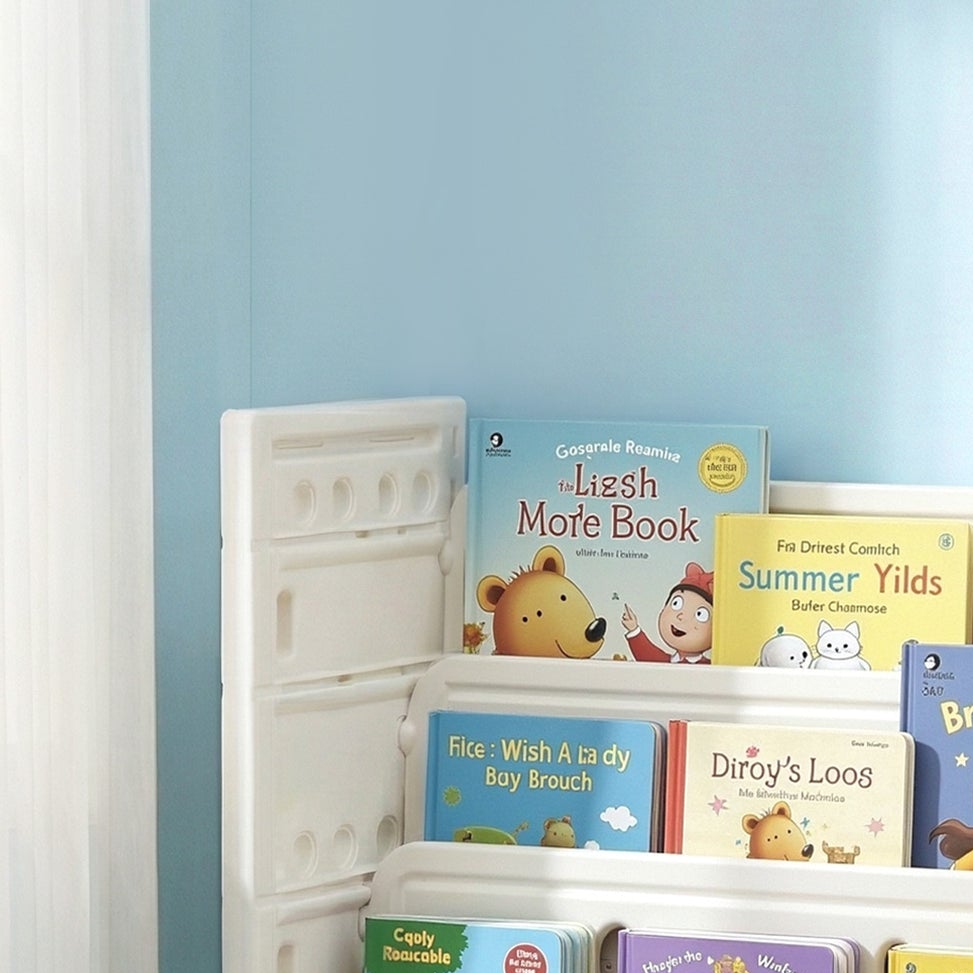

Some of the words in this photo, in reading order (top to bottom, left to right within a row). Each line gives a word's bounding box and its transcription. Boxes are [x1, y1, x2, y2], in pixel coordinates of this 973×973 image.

[610, 504, 699, 542] Book
[738, 561, 860, 593] Summer
[873, 562, 943, 596] Yilds
[501, 738, 552, 763] Wish
[557, 741, 572, 765] A
[485, 766, 522, 793] Bay
[528, 769, 593, 792] Brouch
[808, 757, 874, 789] Loos
